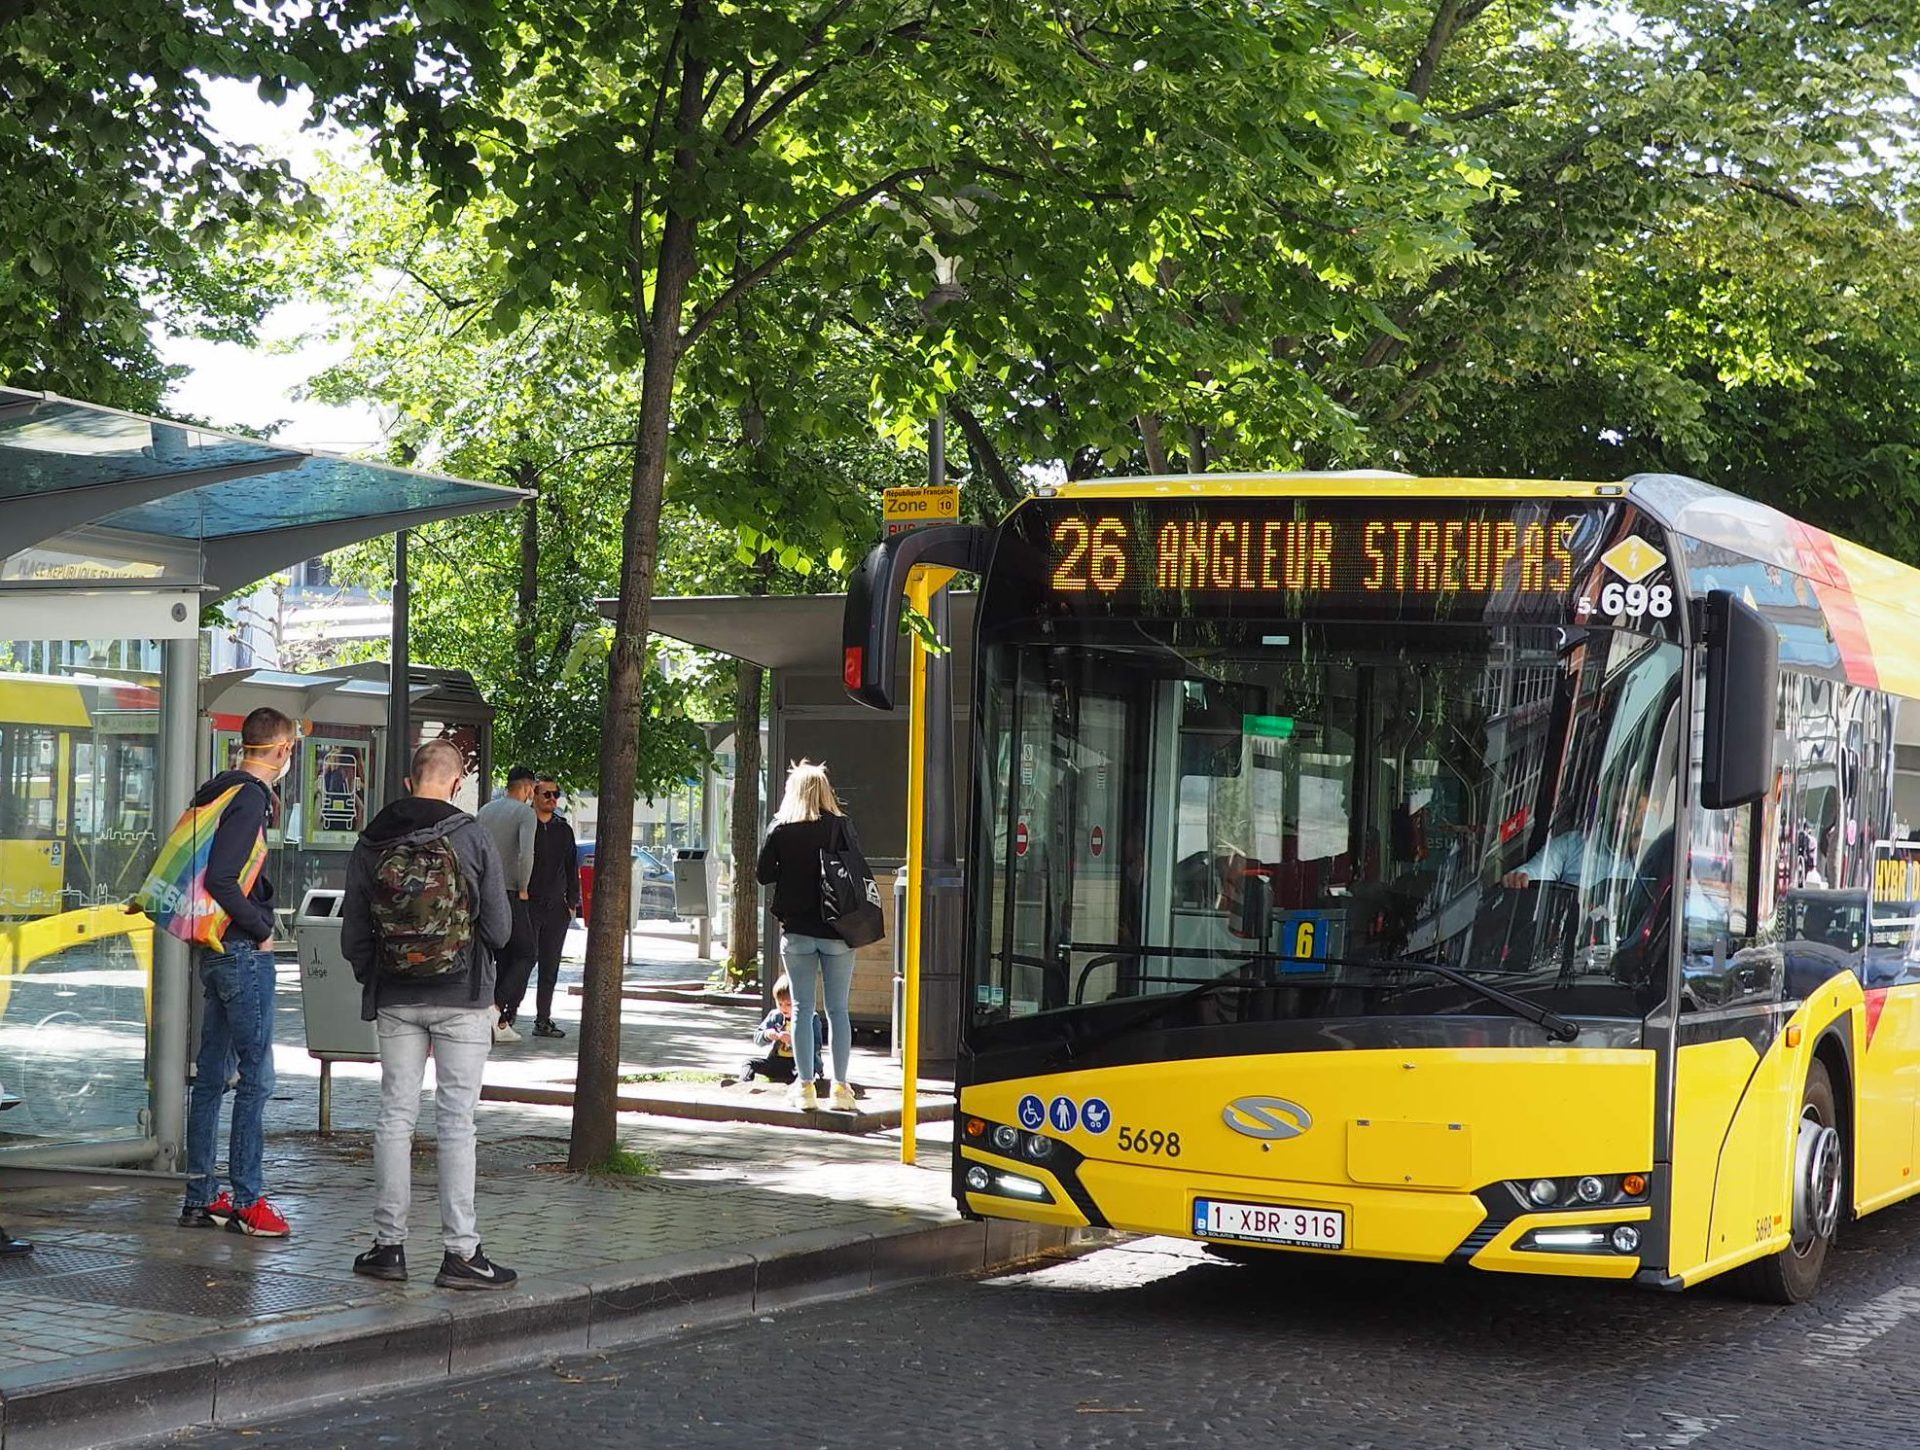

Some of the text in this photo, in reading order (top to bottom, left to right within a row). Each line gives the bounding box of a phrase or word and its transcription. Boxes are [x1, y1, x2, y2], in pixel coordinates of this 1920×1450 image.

[887, 499, 952, 513] Zone 10
[1052, 517, 1573, 591] 26 ANGLEUR STREUPAS
[1296, 922, 1314, 958] 6
[1118, 1126, 1181, 1158] 5698
[1197, 1218, 1206, 1229] B
[1756, 1215, 1772, 1242] 5698
